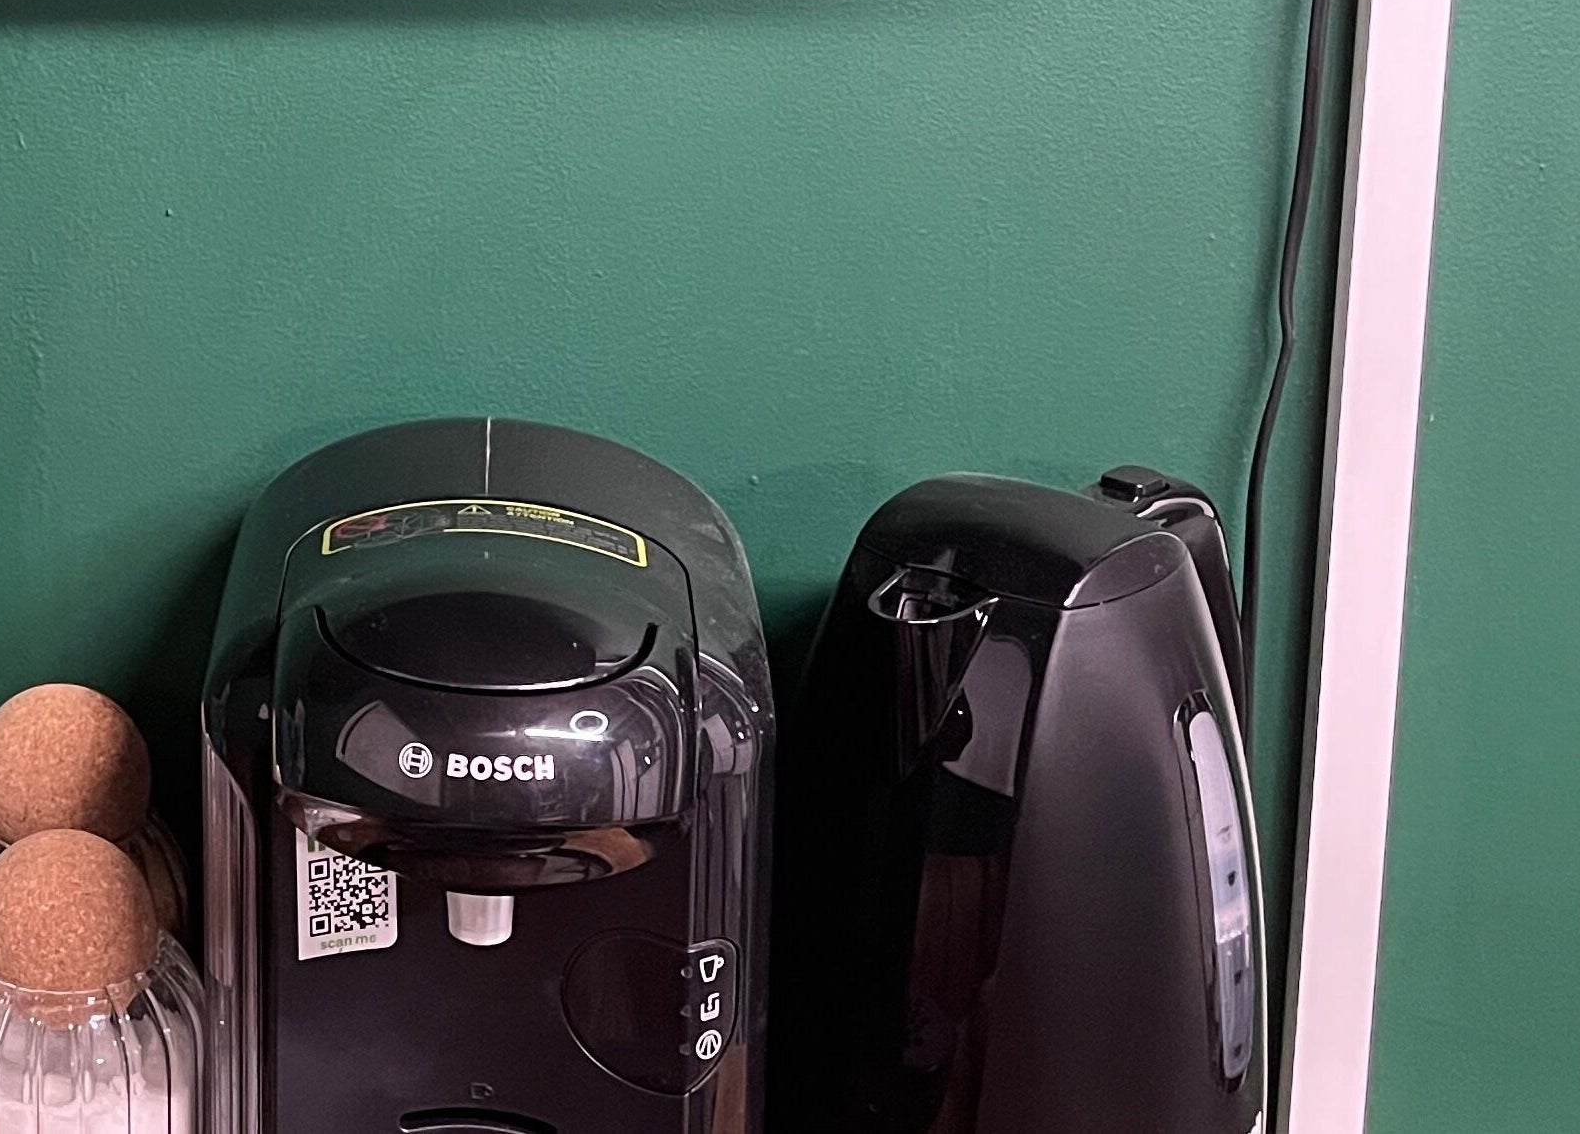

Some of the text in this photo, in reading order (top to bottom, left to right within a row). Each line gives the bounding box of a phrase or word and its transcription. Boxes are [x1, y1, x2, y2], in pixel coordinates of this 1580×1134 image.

[447, 753, 554, 781] BOSCH
[321, 934, 376, 950] scan me
